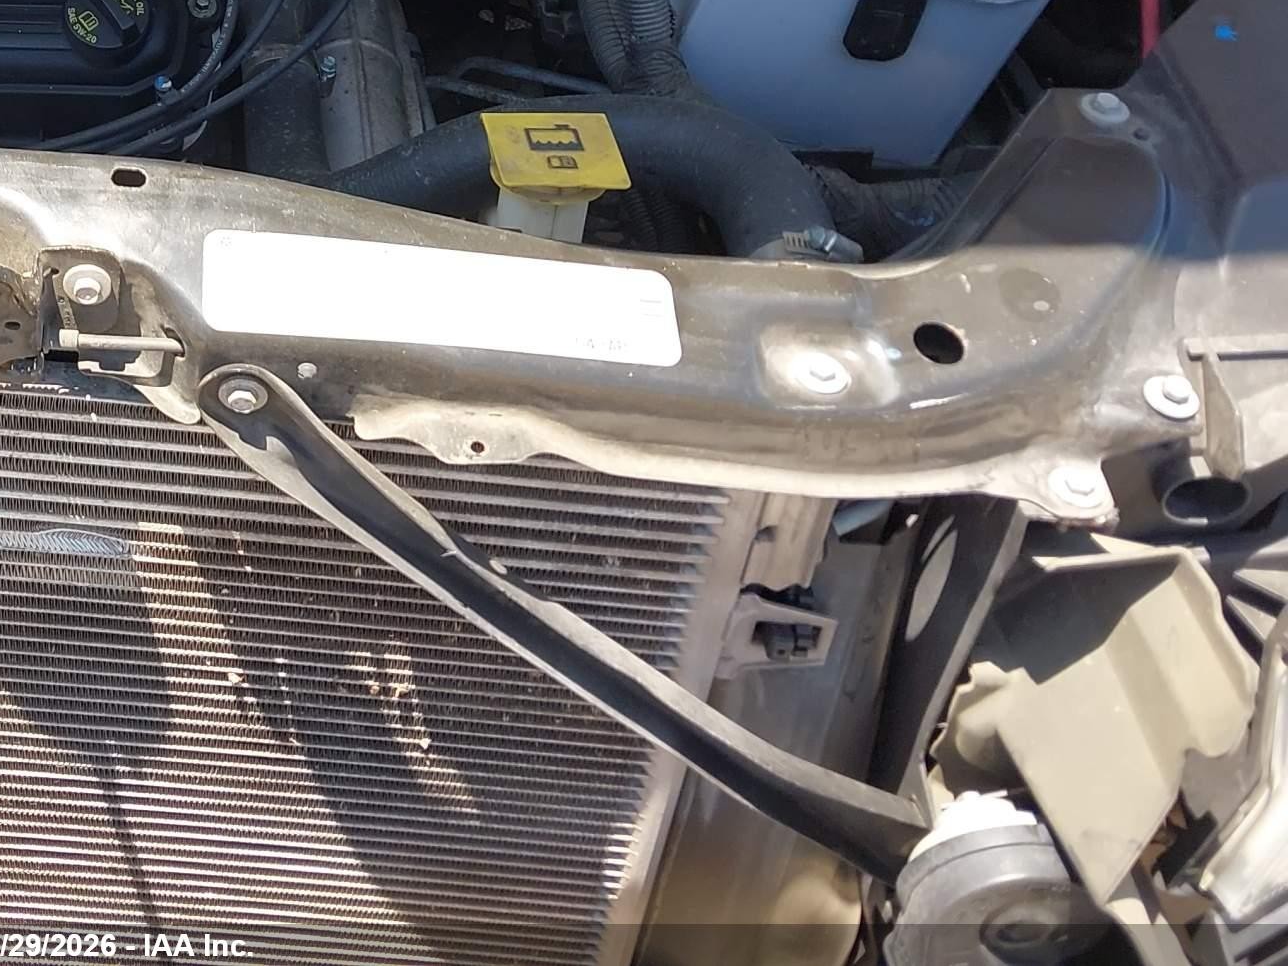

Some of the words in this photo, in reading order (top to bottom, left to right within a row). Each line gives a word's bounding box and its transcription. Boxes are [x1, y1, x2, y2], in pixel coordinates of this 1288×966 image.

[135, 1, 145, 16] OIL
[67, 7, 78, 23] SAE
[73, 23, 97, 44] 5W-20
